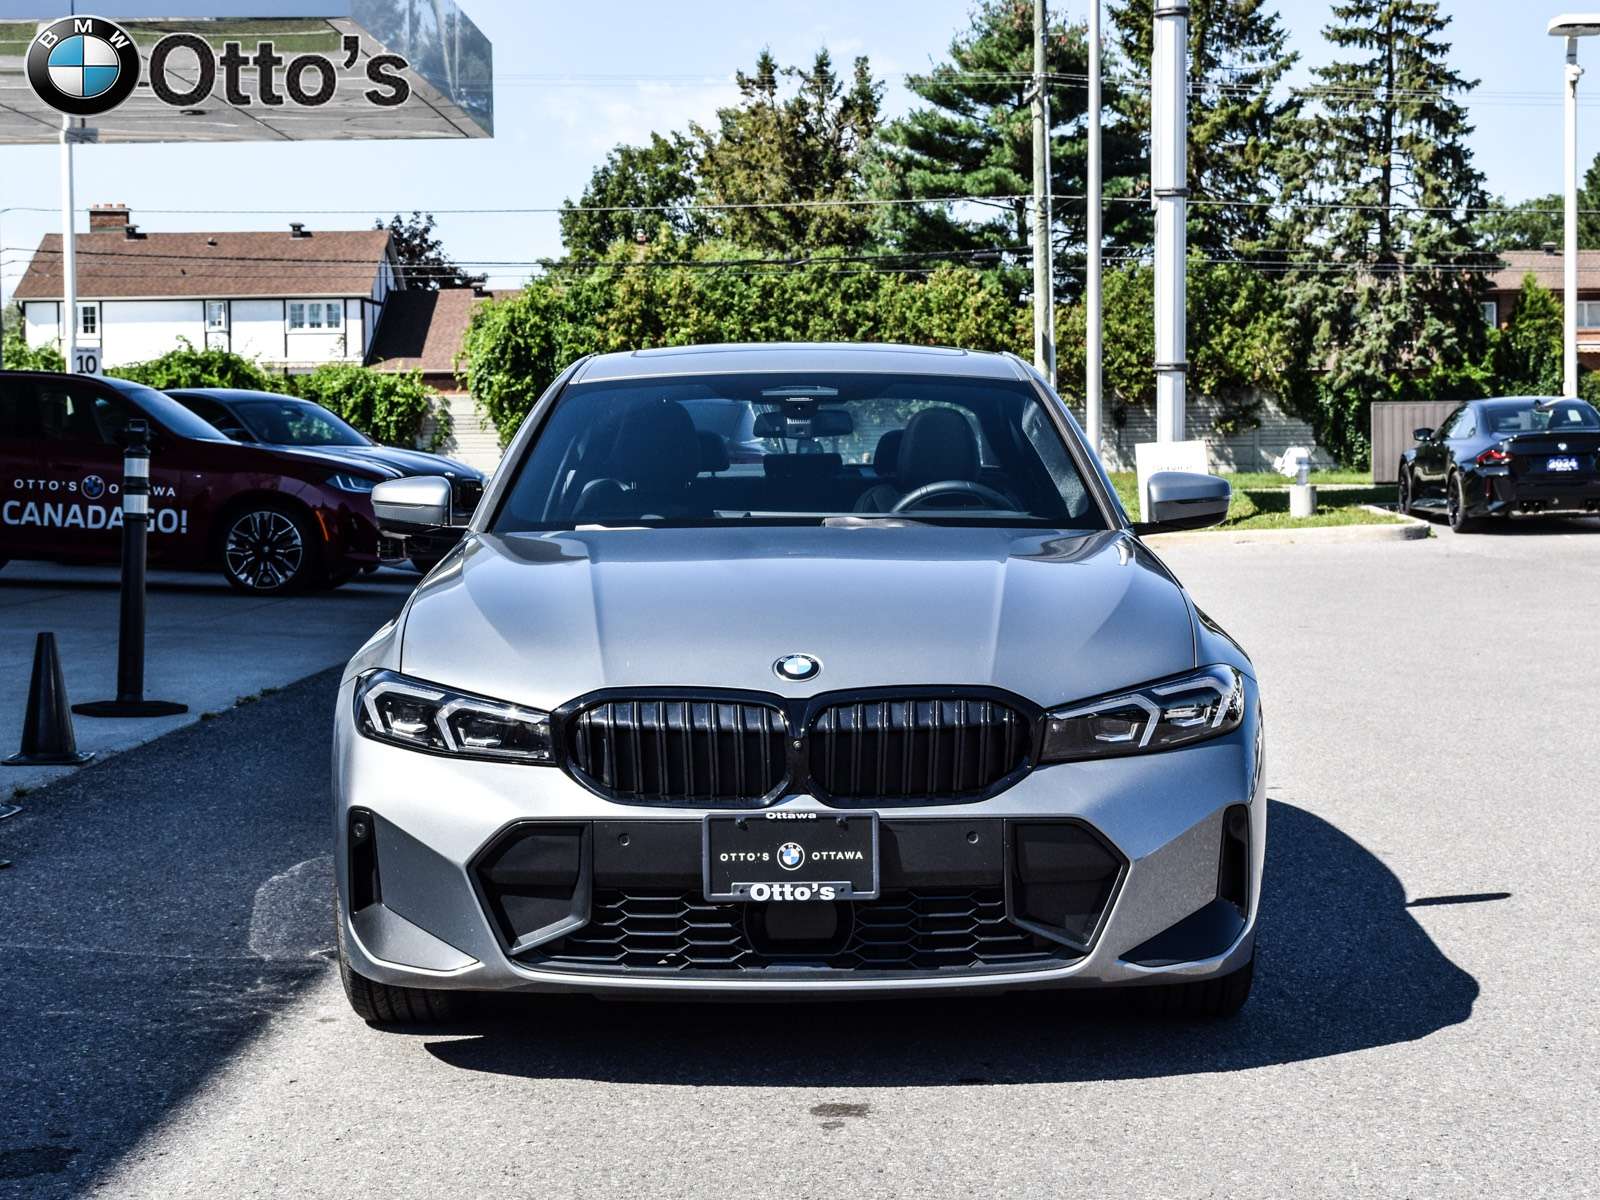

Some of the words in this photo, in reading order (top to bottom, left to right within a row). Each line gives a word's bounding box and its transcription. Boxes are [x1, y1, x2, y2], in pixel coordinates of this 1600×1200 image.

[76, 354, 97, 374] 10
[14, 478, 78, 492] OTTO'S
[108, 483, 176, 497] OWA
[2, 500, 125, 530] CANADA
[765, 812, 817, 820] Ottawa
[720, 852, 770, 862] OTTO'S
[811, 851, 864, 861] OTTAWA
[750, 883, 836, 901] Otto's
